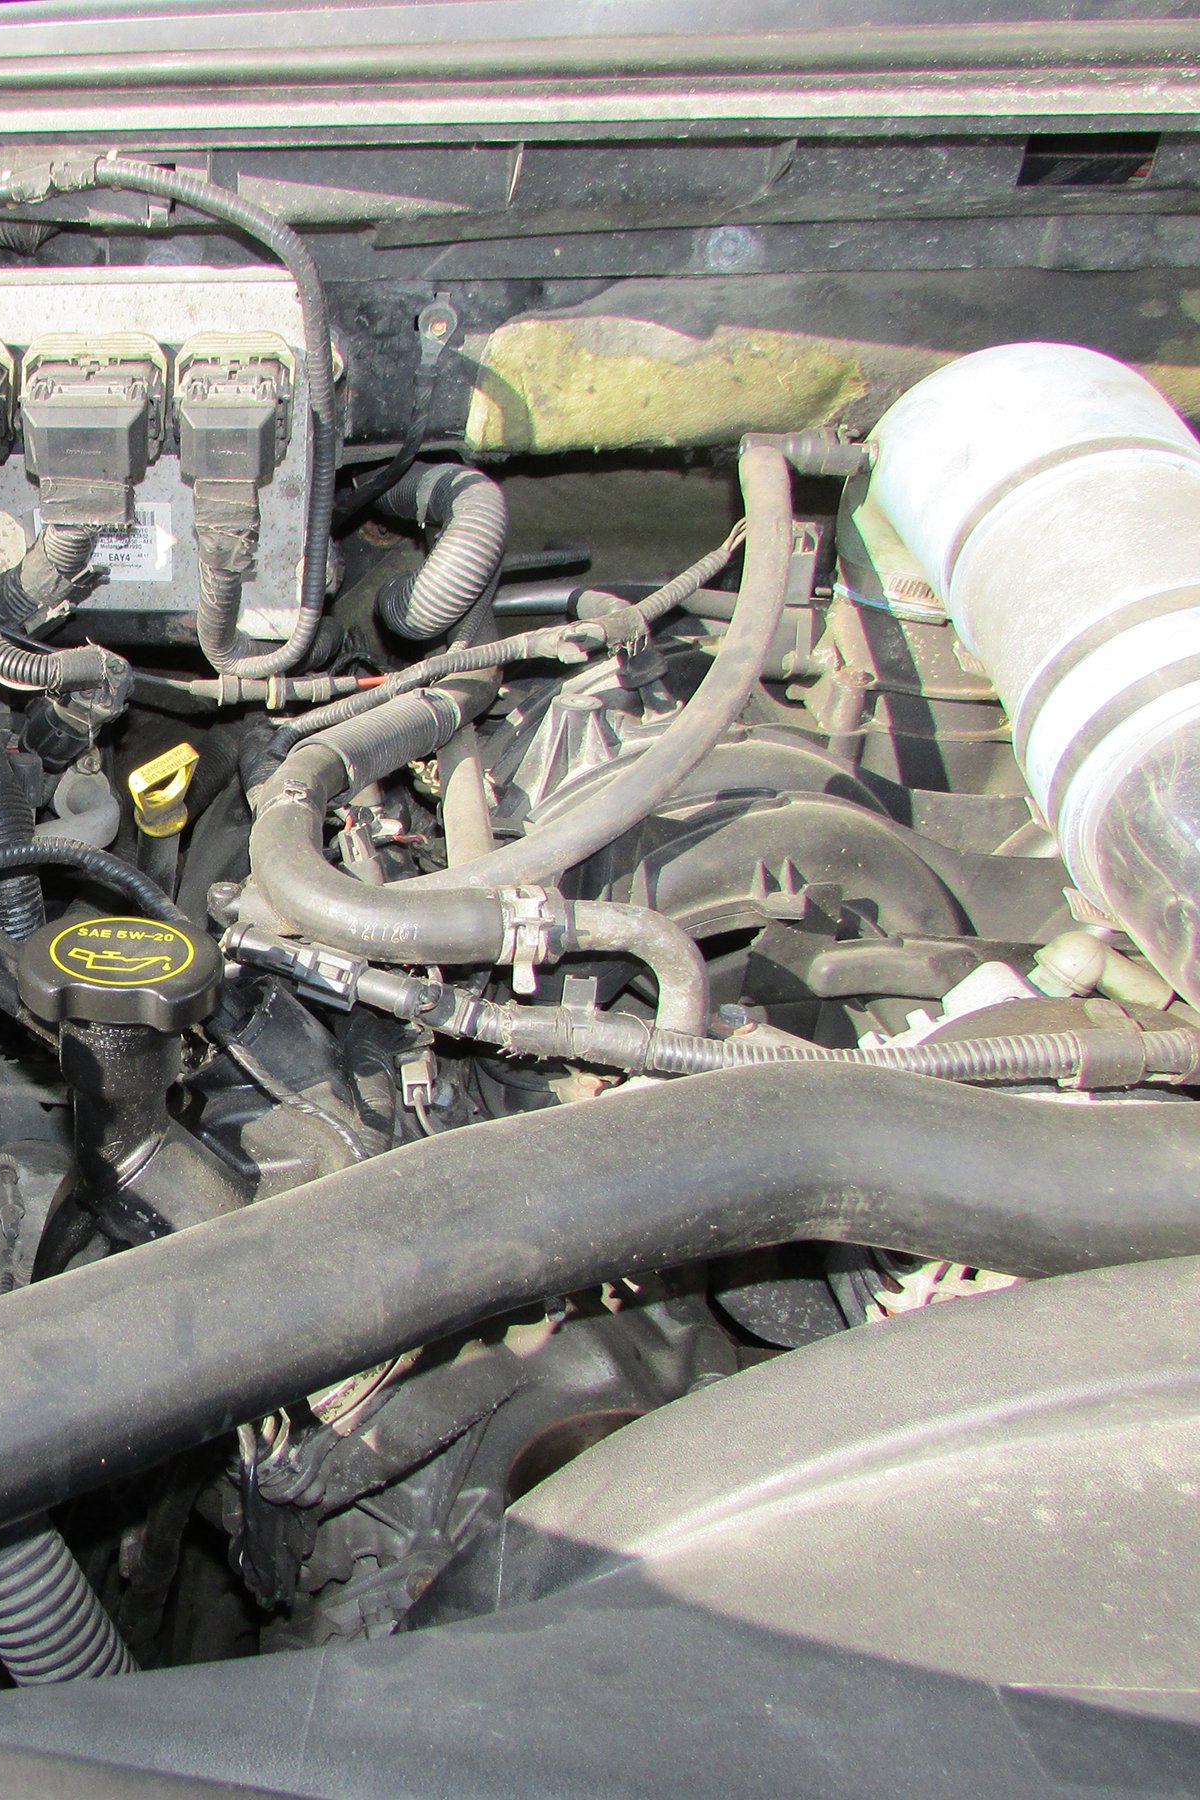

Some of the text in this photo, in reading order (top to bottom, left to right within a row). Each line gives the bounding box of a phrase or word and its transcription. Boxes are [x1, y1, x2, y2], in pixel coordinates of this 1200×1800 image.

[108, 553, 131, 562] EAY4
[144, 769, 167, 784] FLUID
[77, 927, 175, 942] SAE 5W-20
